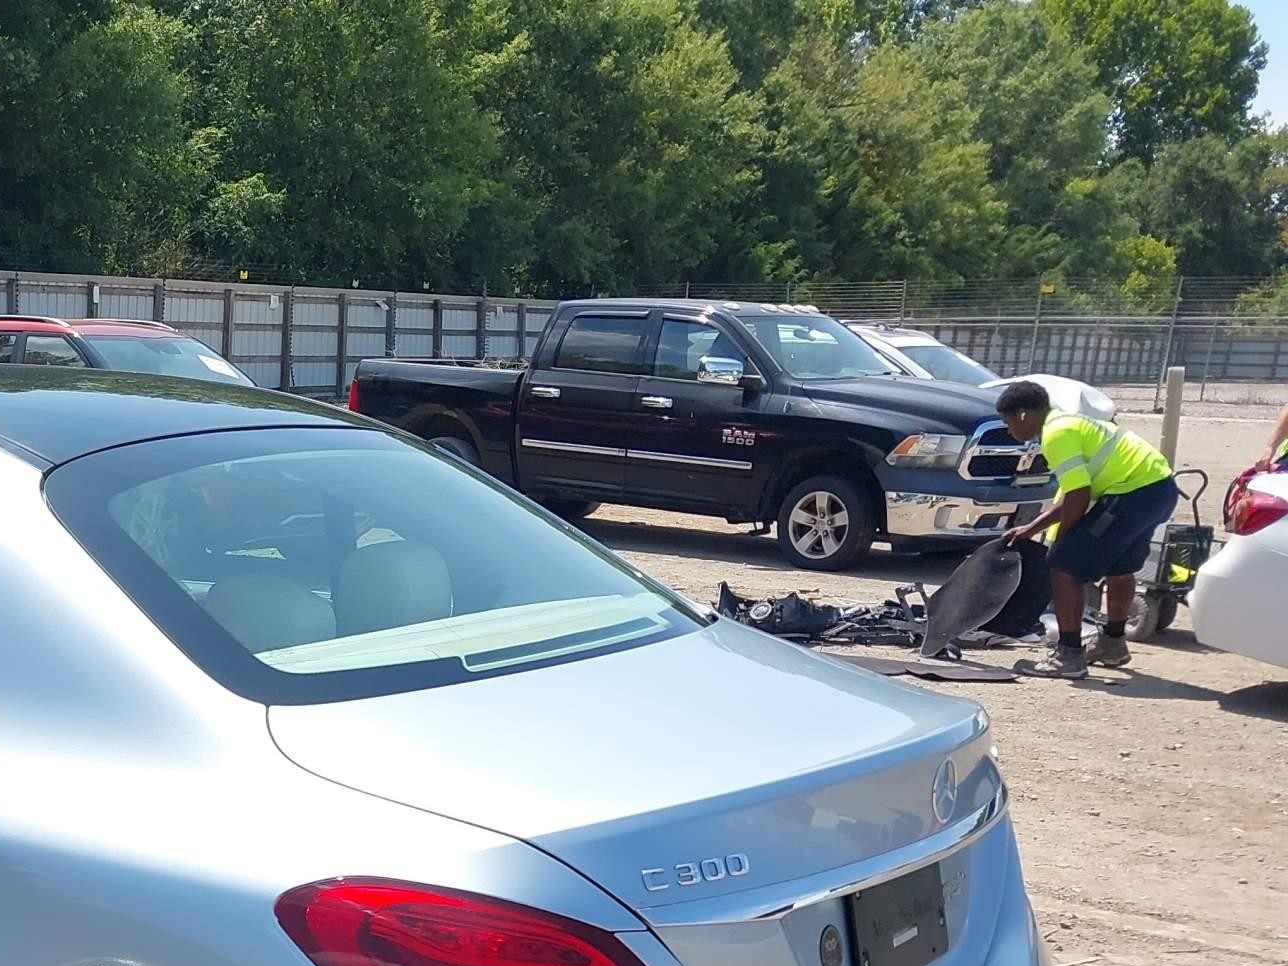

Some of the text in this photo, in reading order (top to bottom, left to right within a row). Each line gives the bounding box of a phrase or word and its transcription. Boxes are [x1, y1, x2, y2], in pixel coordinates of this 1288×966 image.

[722, 428, 756, 438] RAM
[722, 436, 755, 446] 1500
[641, 853, 750, 892] C 300
